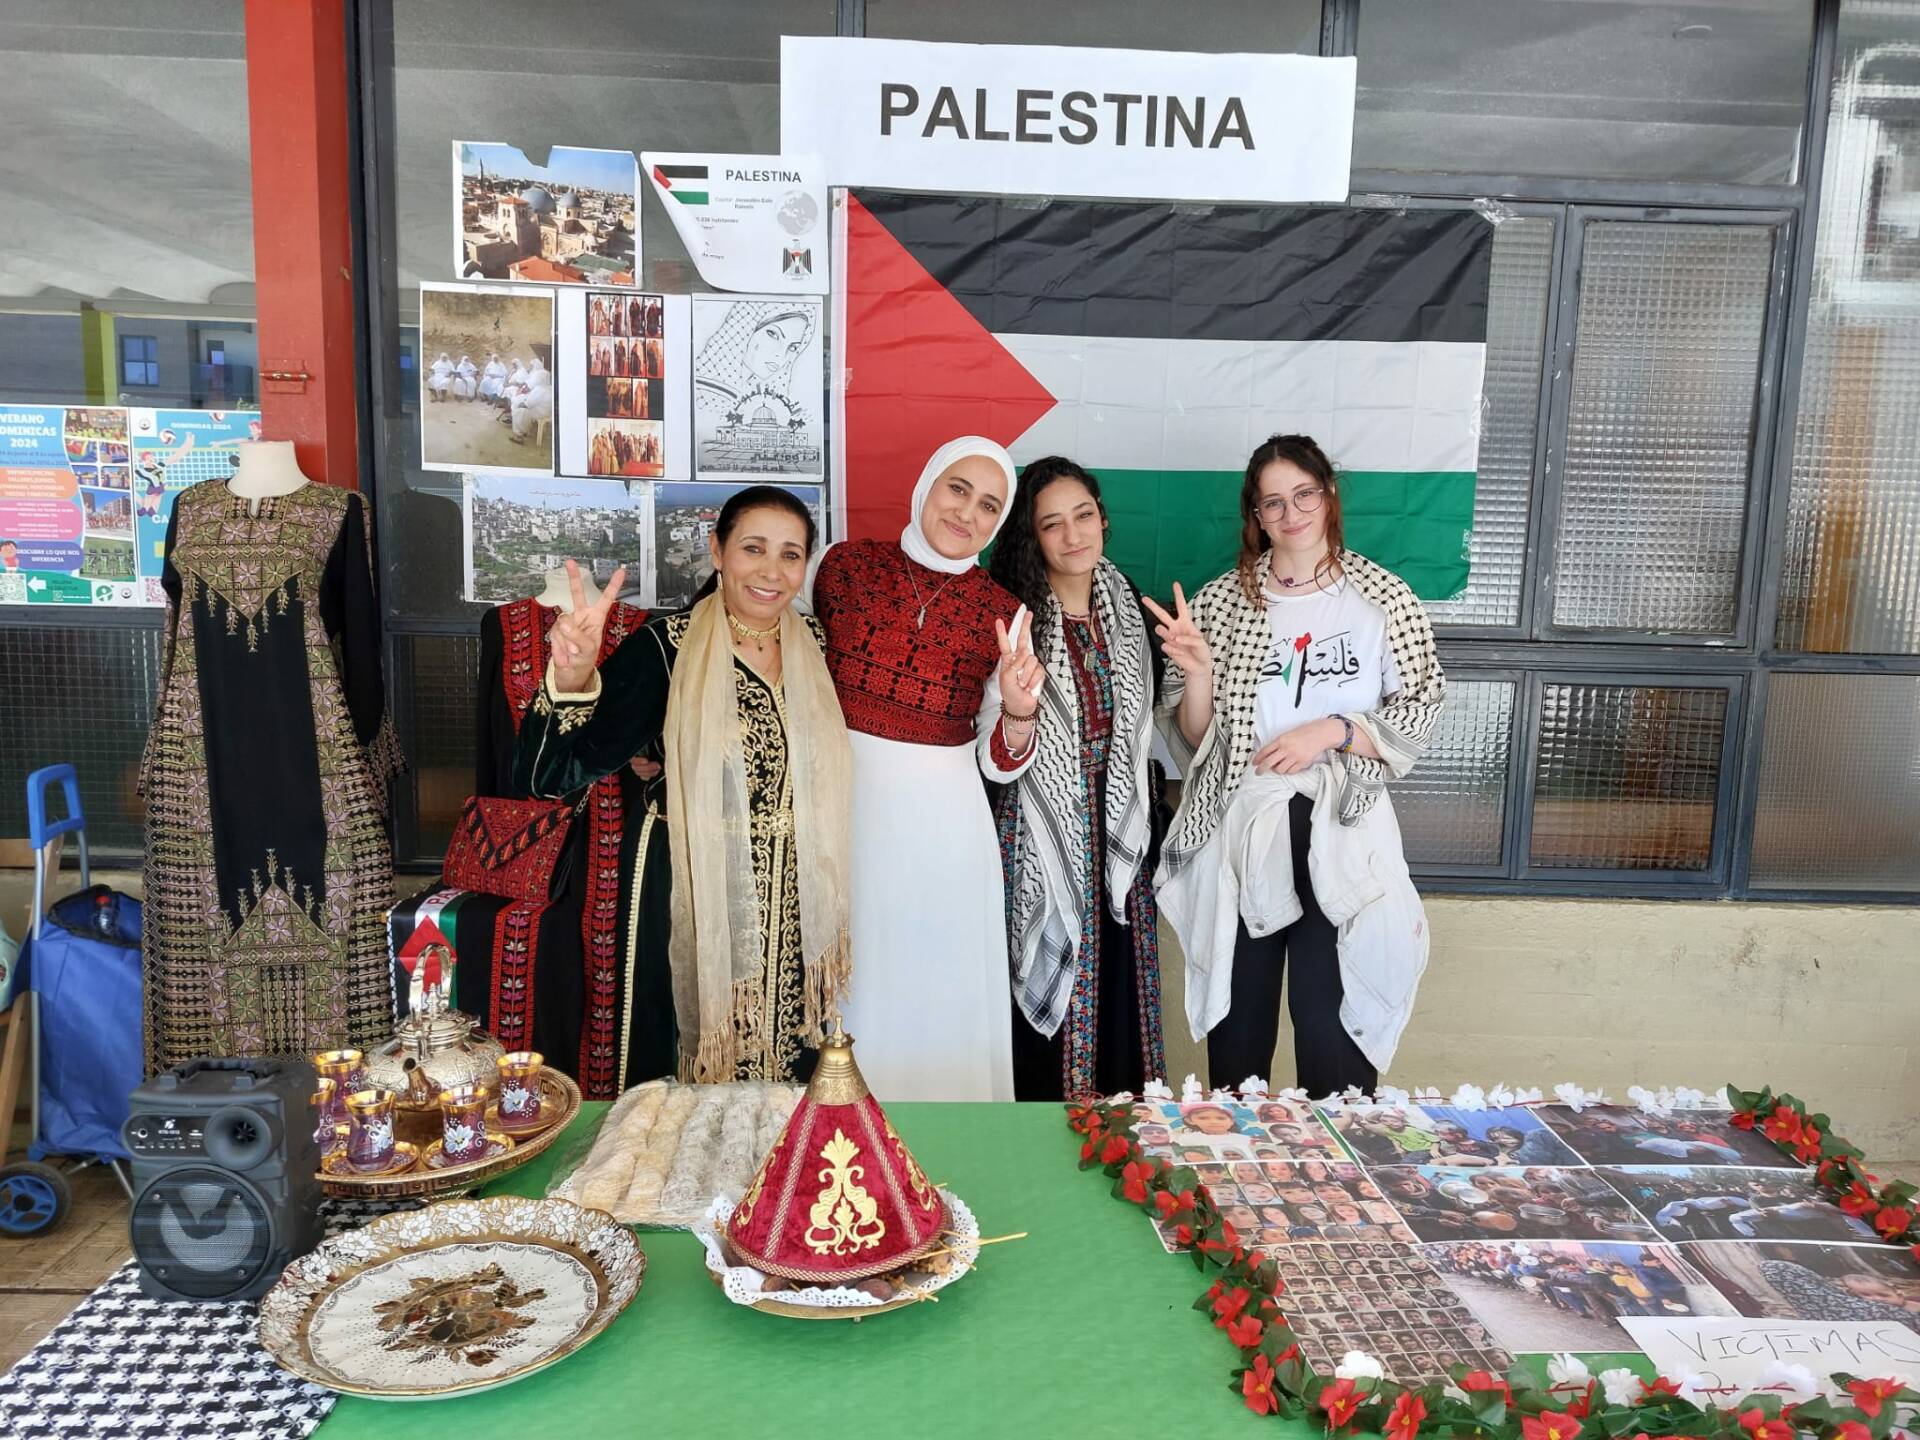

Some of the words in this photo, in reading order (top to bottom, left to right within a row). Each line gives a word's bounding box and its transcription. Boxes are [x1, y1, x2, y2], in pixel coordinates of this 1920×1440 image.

[880, 83, 1256, 151] PALESTINA
[726, 169, 802, 183] PALESTINA
[0, 413, 45, 424] VERANO
[0, 425, 57, 437] OMINICAS
[10, 438, 39, 448] 2024
[1666, 1328, 1920, 1364] VICTIMAS
